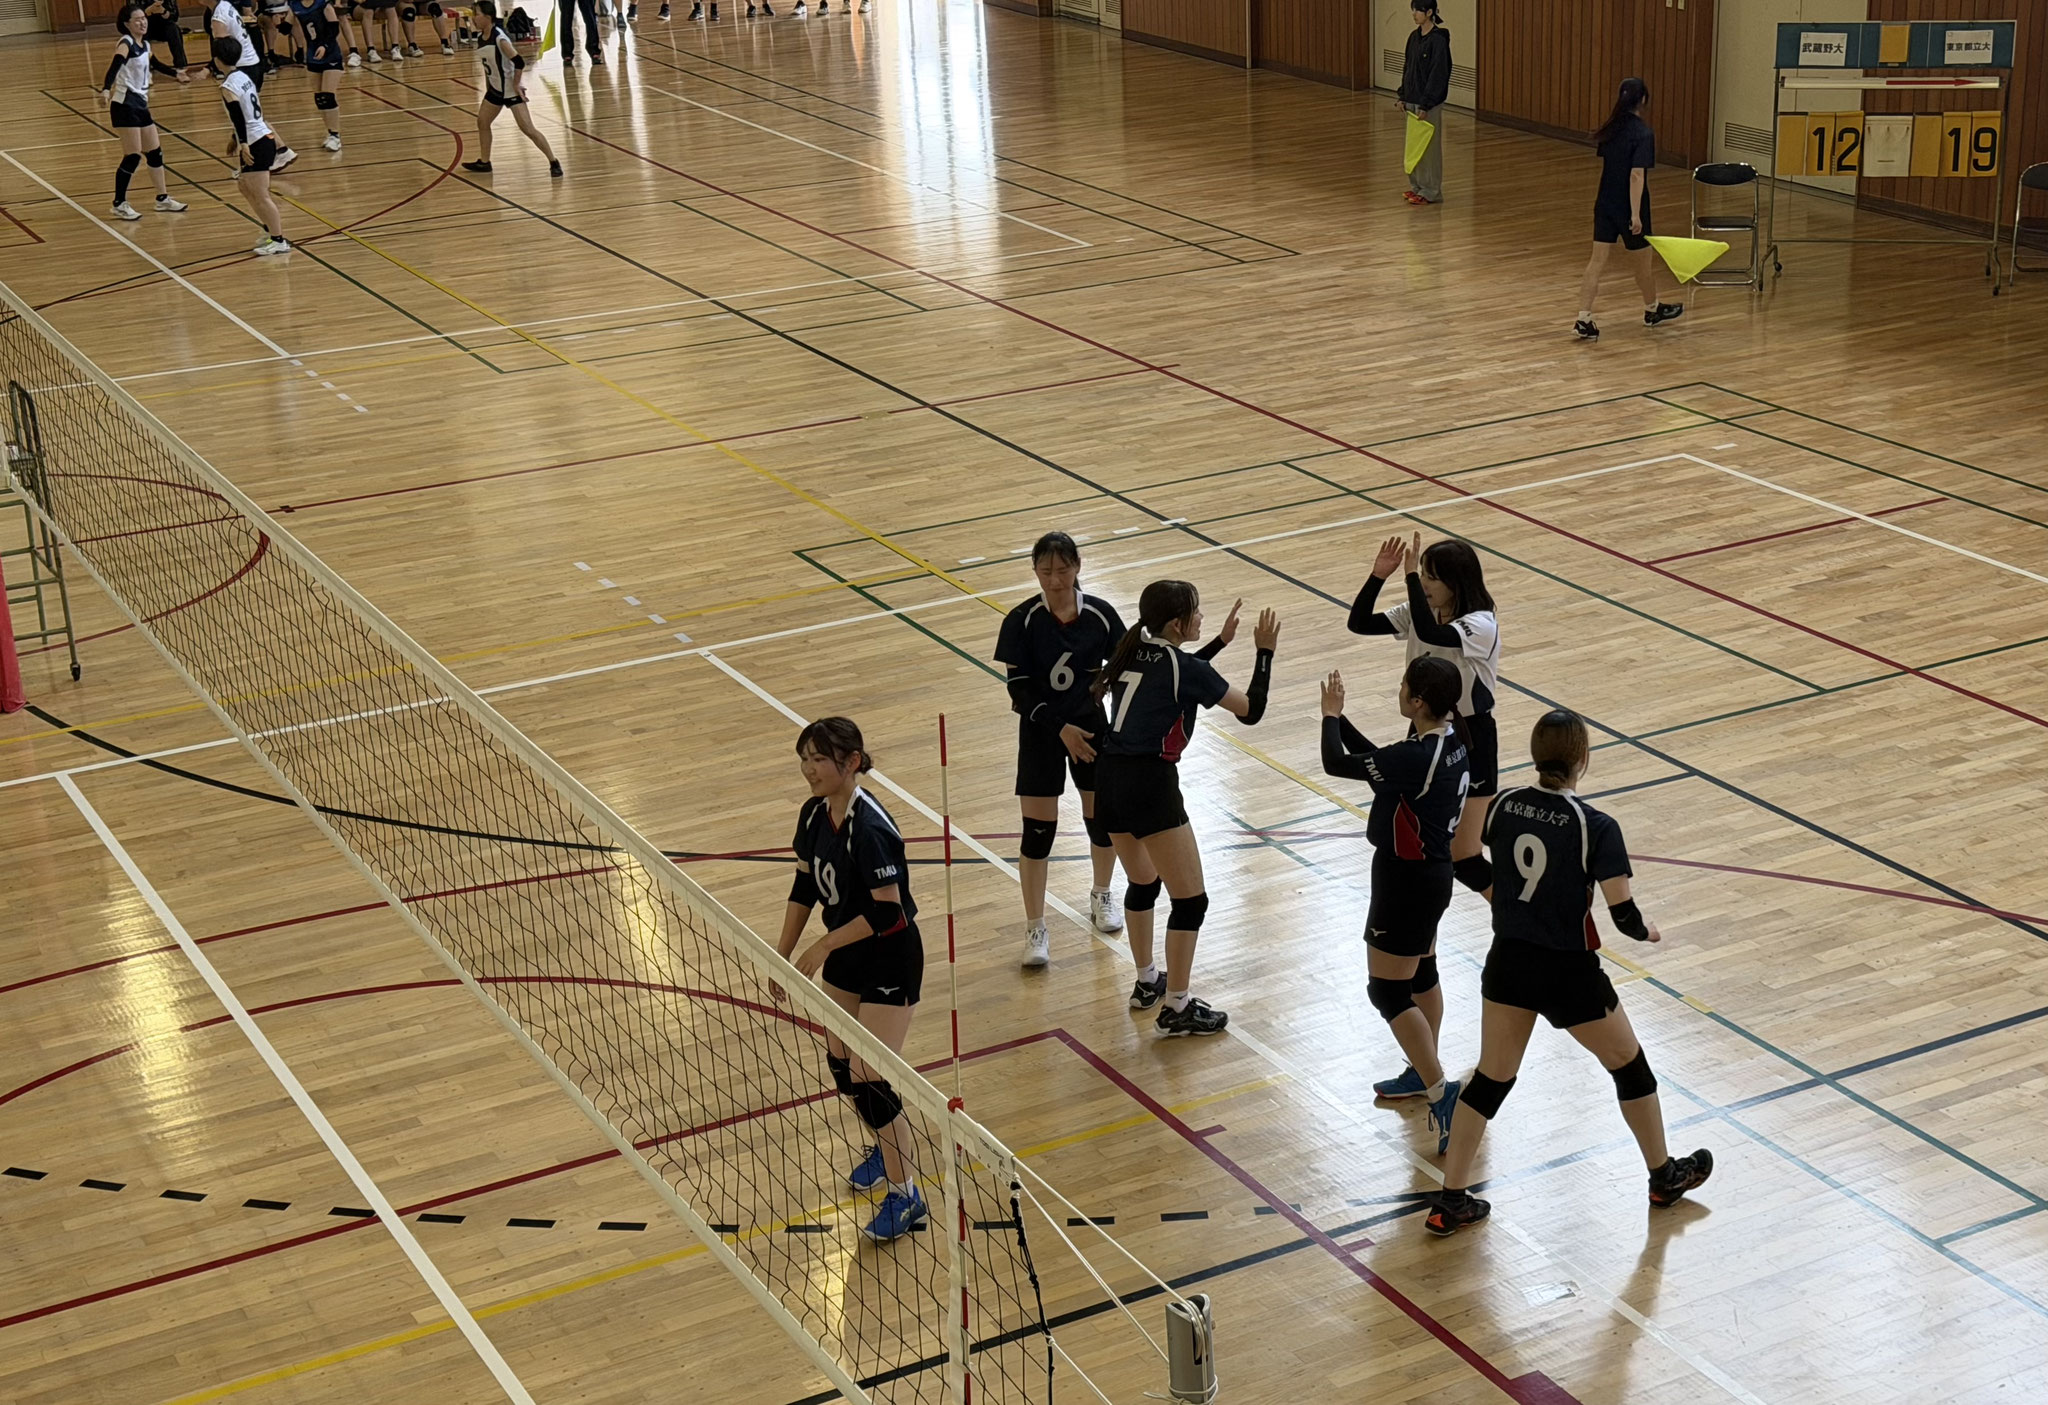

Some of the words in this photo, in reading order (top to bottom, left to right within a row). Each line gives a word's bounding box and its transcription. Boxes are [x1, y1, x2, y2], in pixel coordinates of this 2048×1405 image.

[1801, 42, 1845, 54] 武蔵野大
[1946, 41, 1991, 52] 東京都立大
[249, 92, 262, 120] 8
[1812, 126, 1860, 172] 12
[1947, 126, 1998, 172] 19
[1049, 651, 1075, 691] 6
[1112, 670, 1144, 733] 7
[1363, 757, 1385, 782] TMU
[1503, 800, 1570, 827] 東京都立大学
[873, 864, 898, 880] TMU
[1513, 833, 1548, 903] 9
